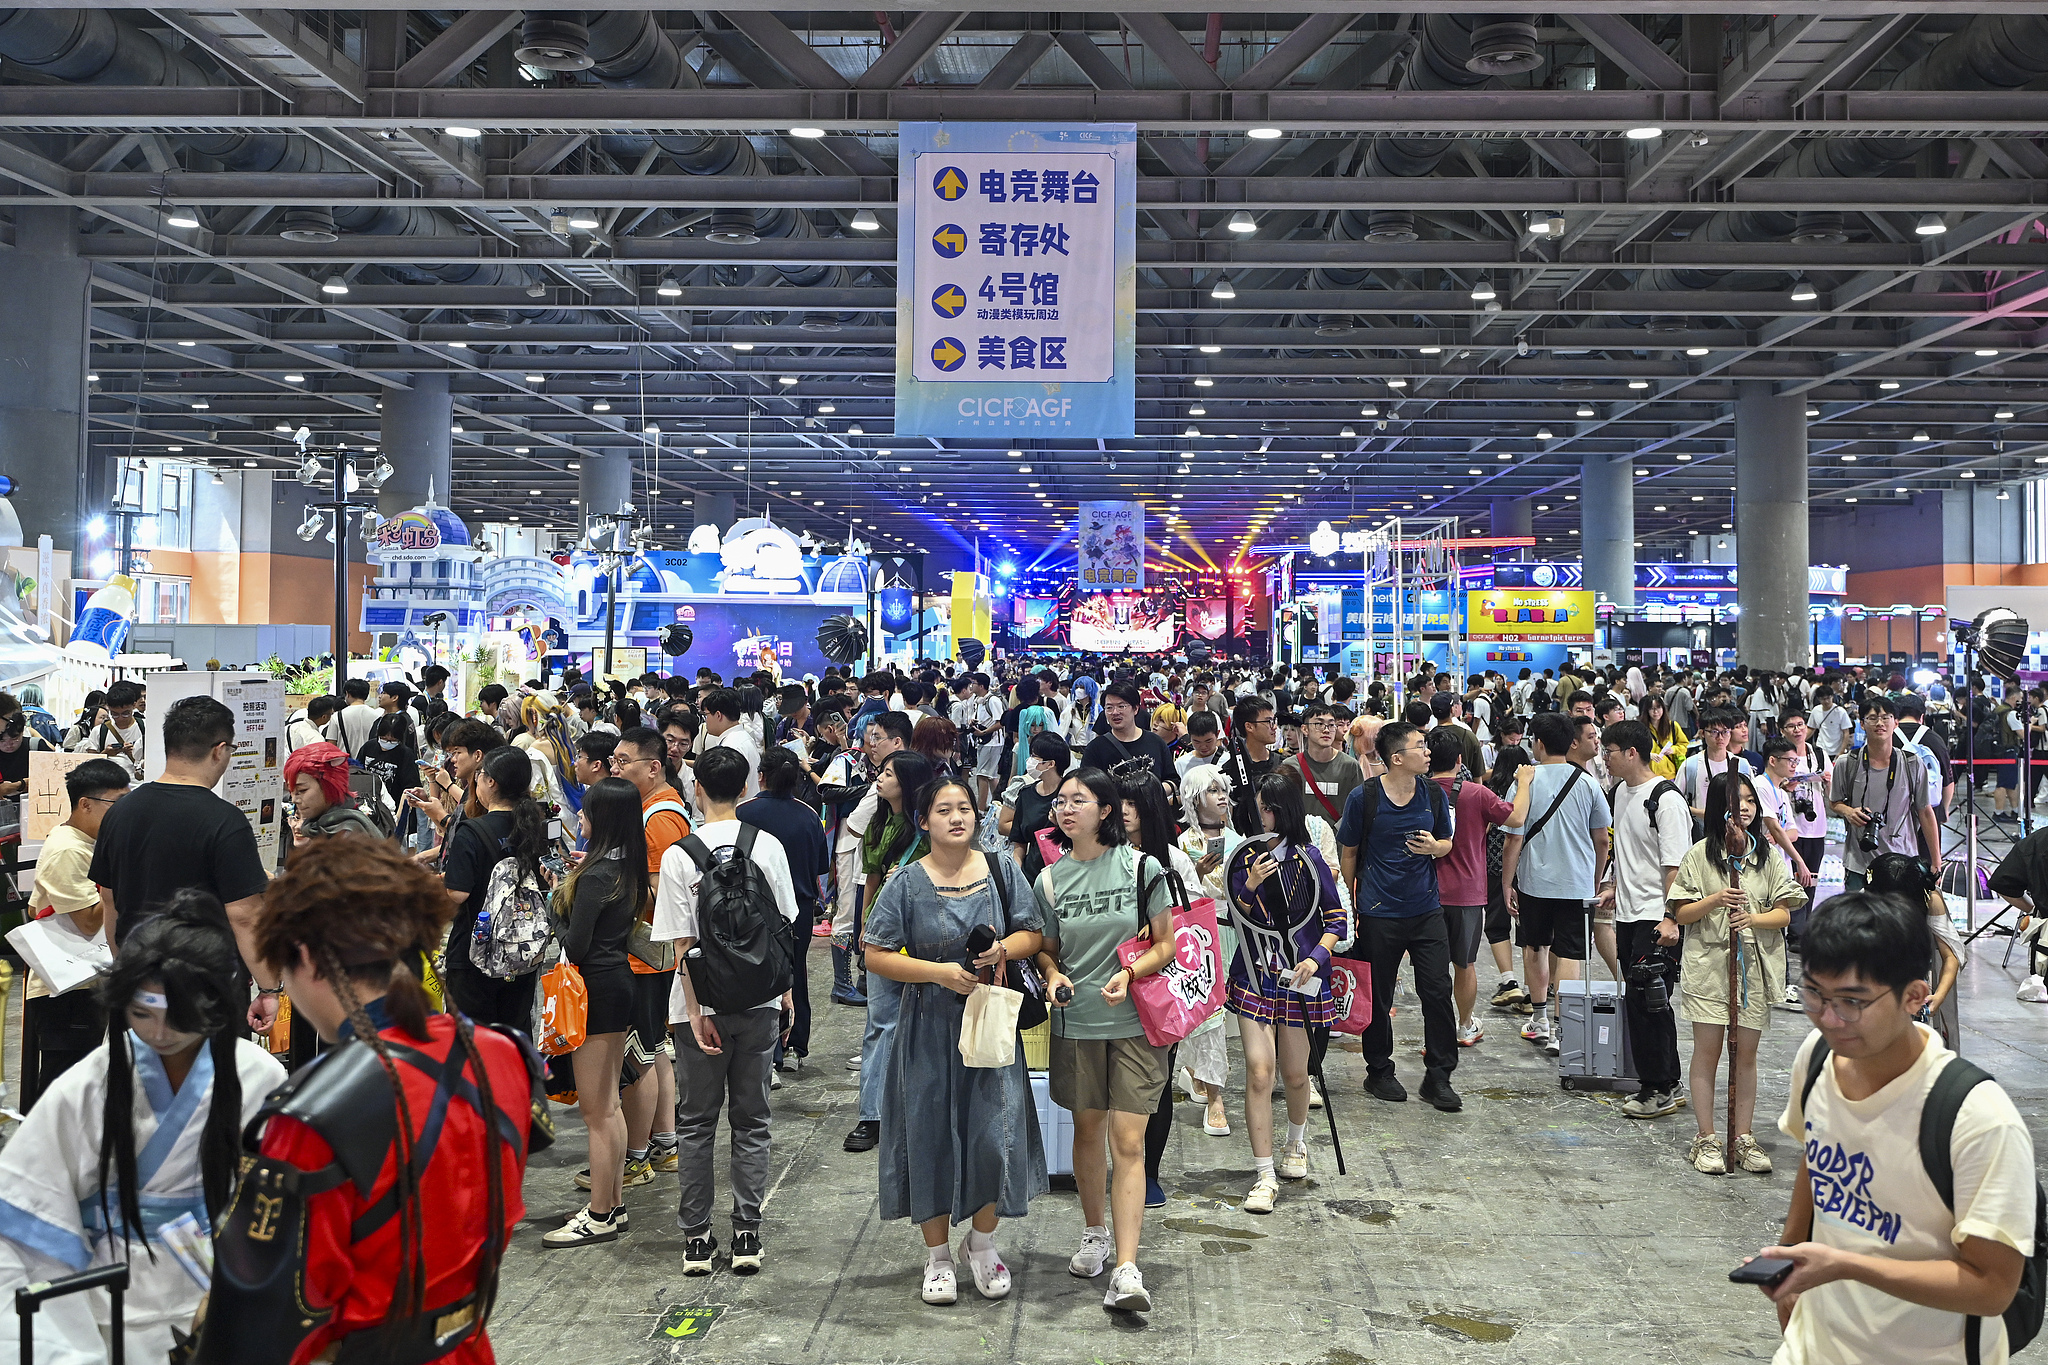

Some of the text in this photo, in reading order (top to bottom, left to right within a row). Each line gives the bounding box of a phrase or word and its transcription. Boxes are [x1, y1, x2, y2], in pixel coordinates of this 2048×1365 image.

[979, 169, 1100, 204] 电竞舞台
[978, 222, 1070, 257] 寄存处
[978, 272, 1059, 306] 4号馆
[976, 309, 1059, 321] 动漫类模玩周边
[977, 335, 1067, 370] 美食区
[958, 398, 1071, 417] CICF AGF
[665, 558, 688, 567] 3C02
[1084, 568, 1138, 583] 电竞舞台
[1502, 634, 1519, 642] H02
